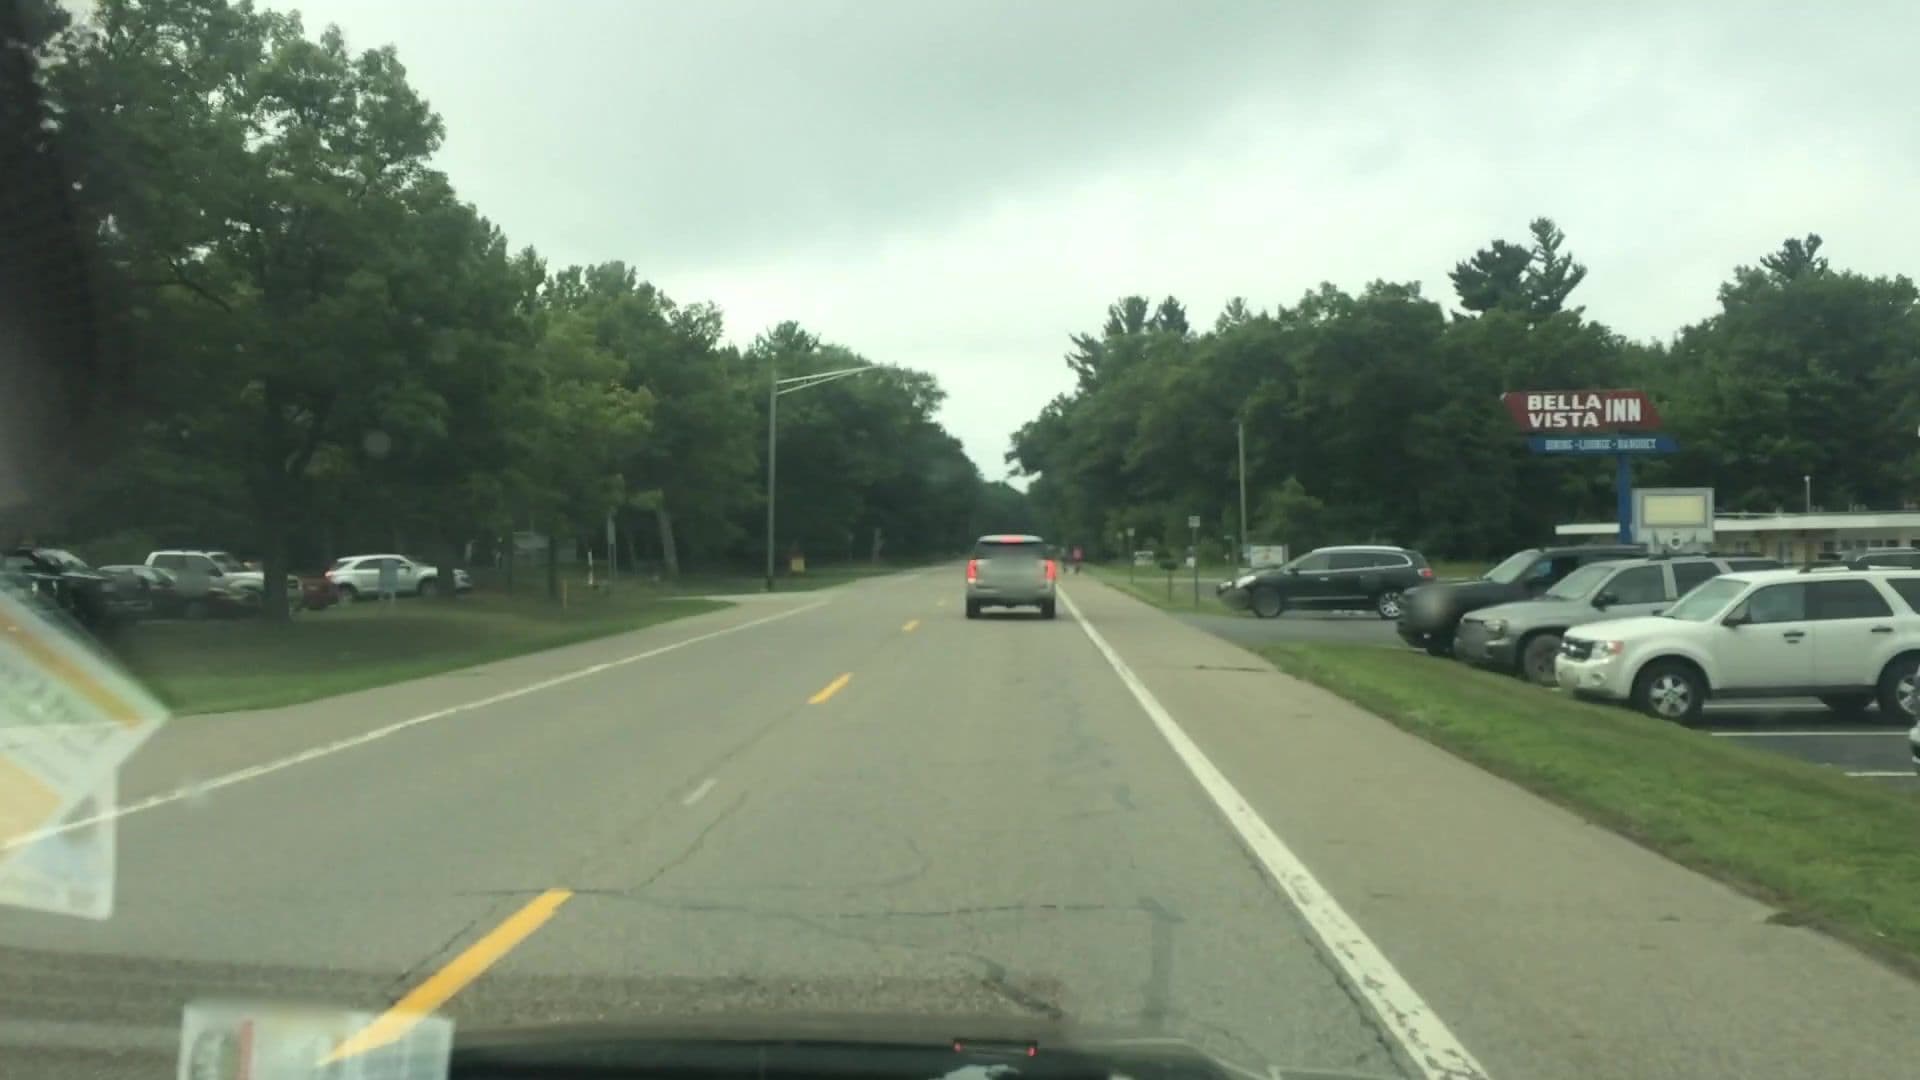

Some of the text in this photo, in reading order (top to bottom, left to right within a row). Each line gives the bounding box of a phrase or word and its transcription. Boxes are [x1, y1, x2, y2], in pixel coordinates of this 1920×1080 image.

[1528, 394, 1602, 411] BELLA
[1605, 398, 1641, 422] INN
[1528, 412, 1600, 428] VISTA
